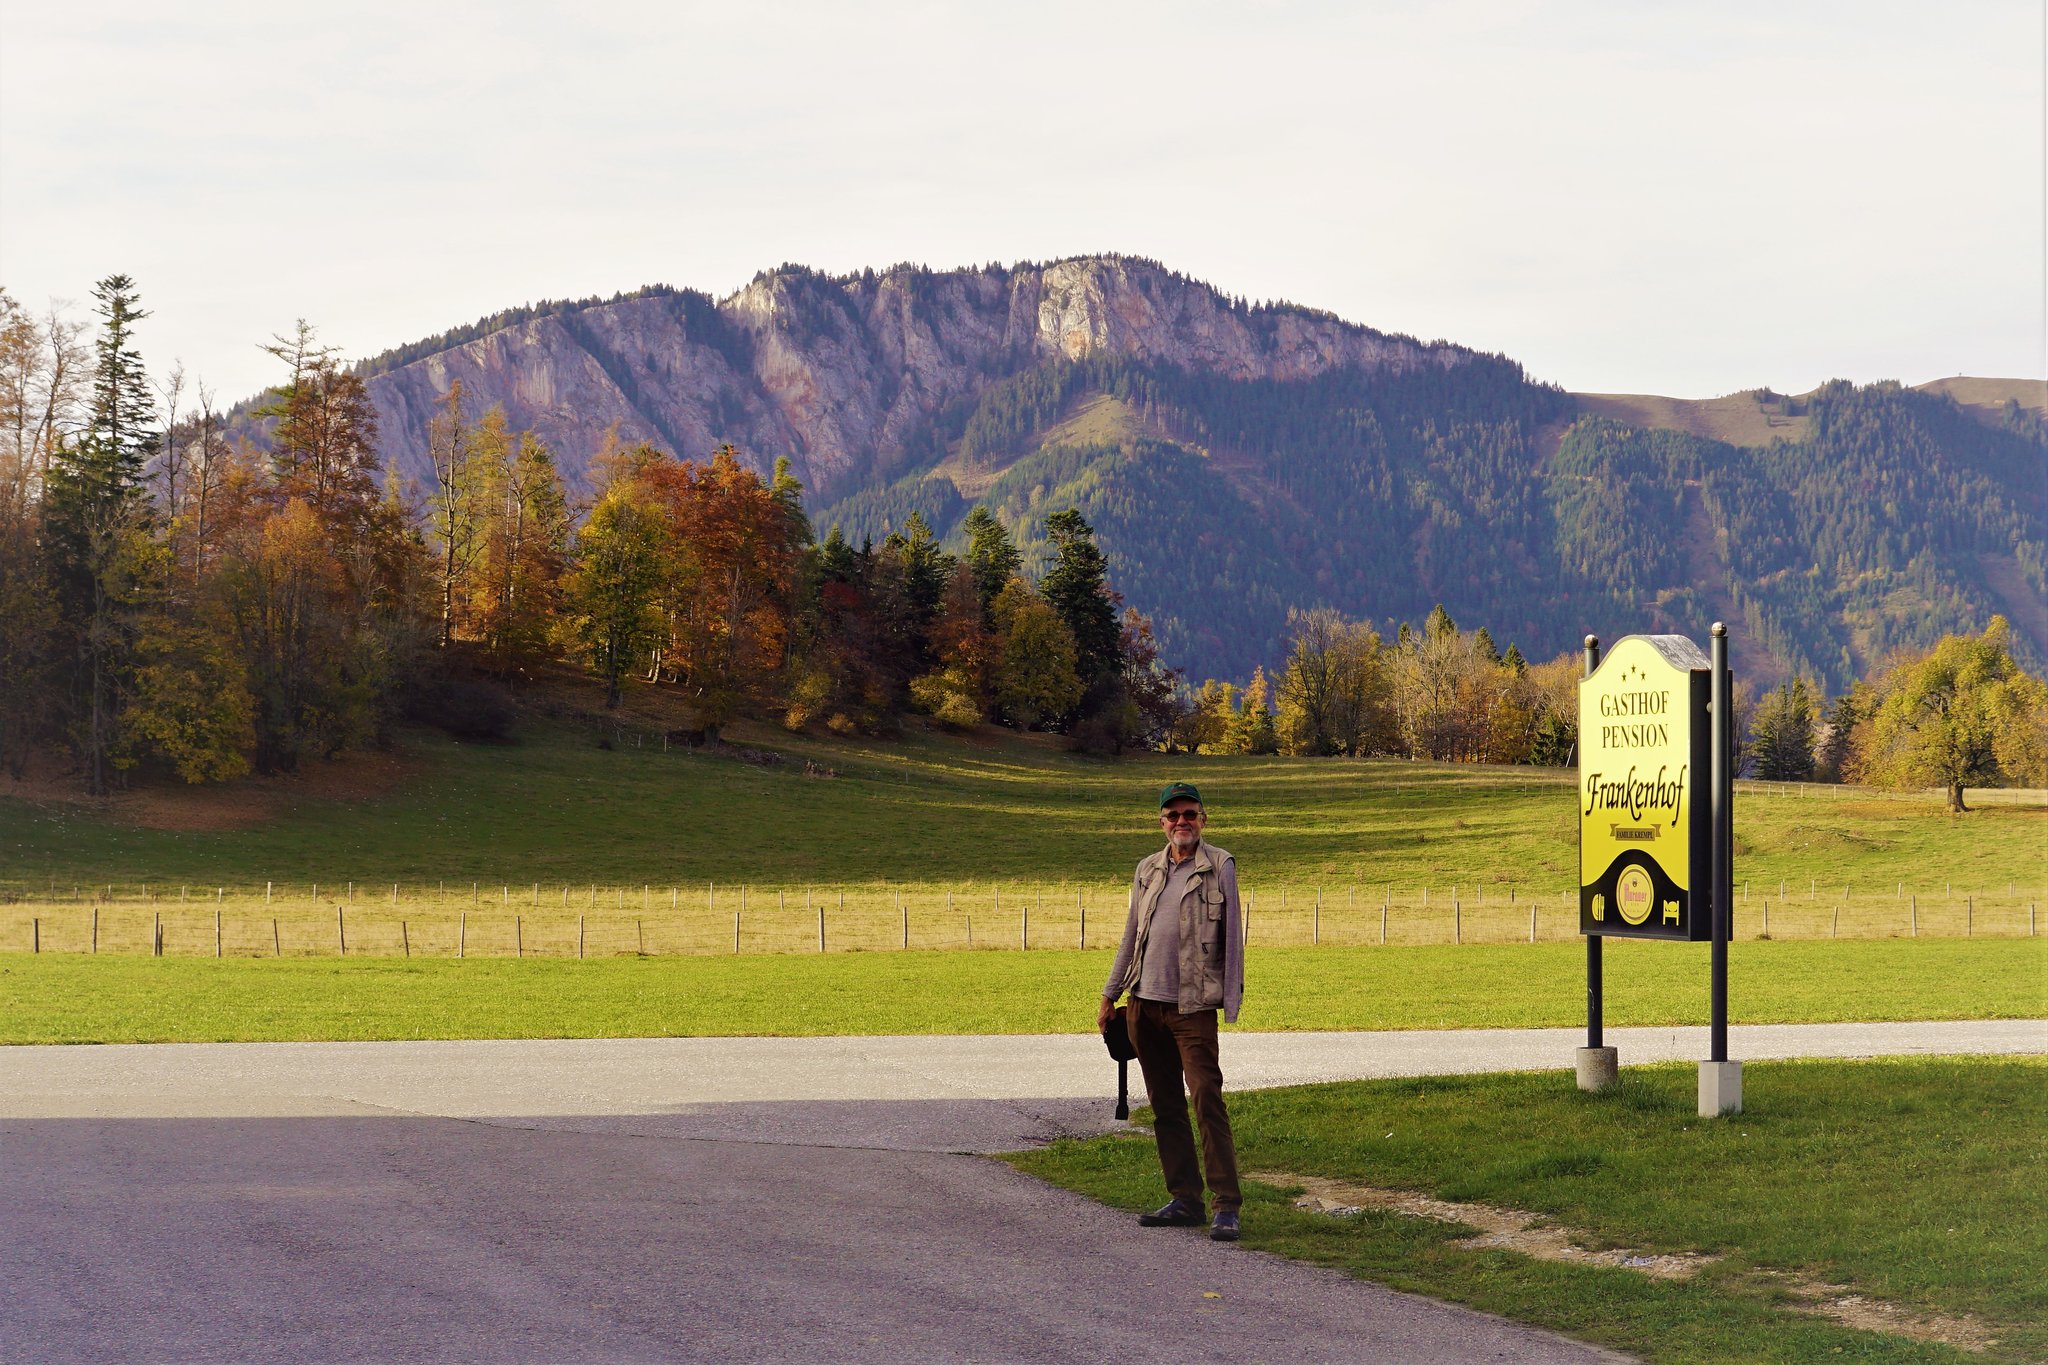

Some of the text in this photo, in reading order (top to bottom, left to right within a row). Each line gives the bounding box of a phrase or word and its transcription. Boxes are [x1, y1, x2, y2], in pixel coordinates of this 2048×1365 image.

[1600, 691, 1669, 717] GASTHOF
[1602, 724, 1668, 748] PENSION
[1585, 764, 1687, 828] Frankenhof
[1616, 831, 1654, 839] FAMILIE KREMPL
